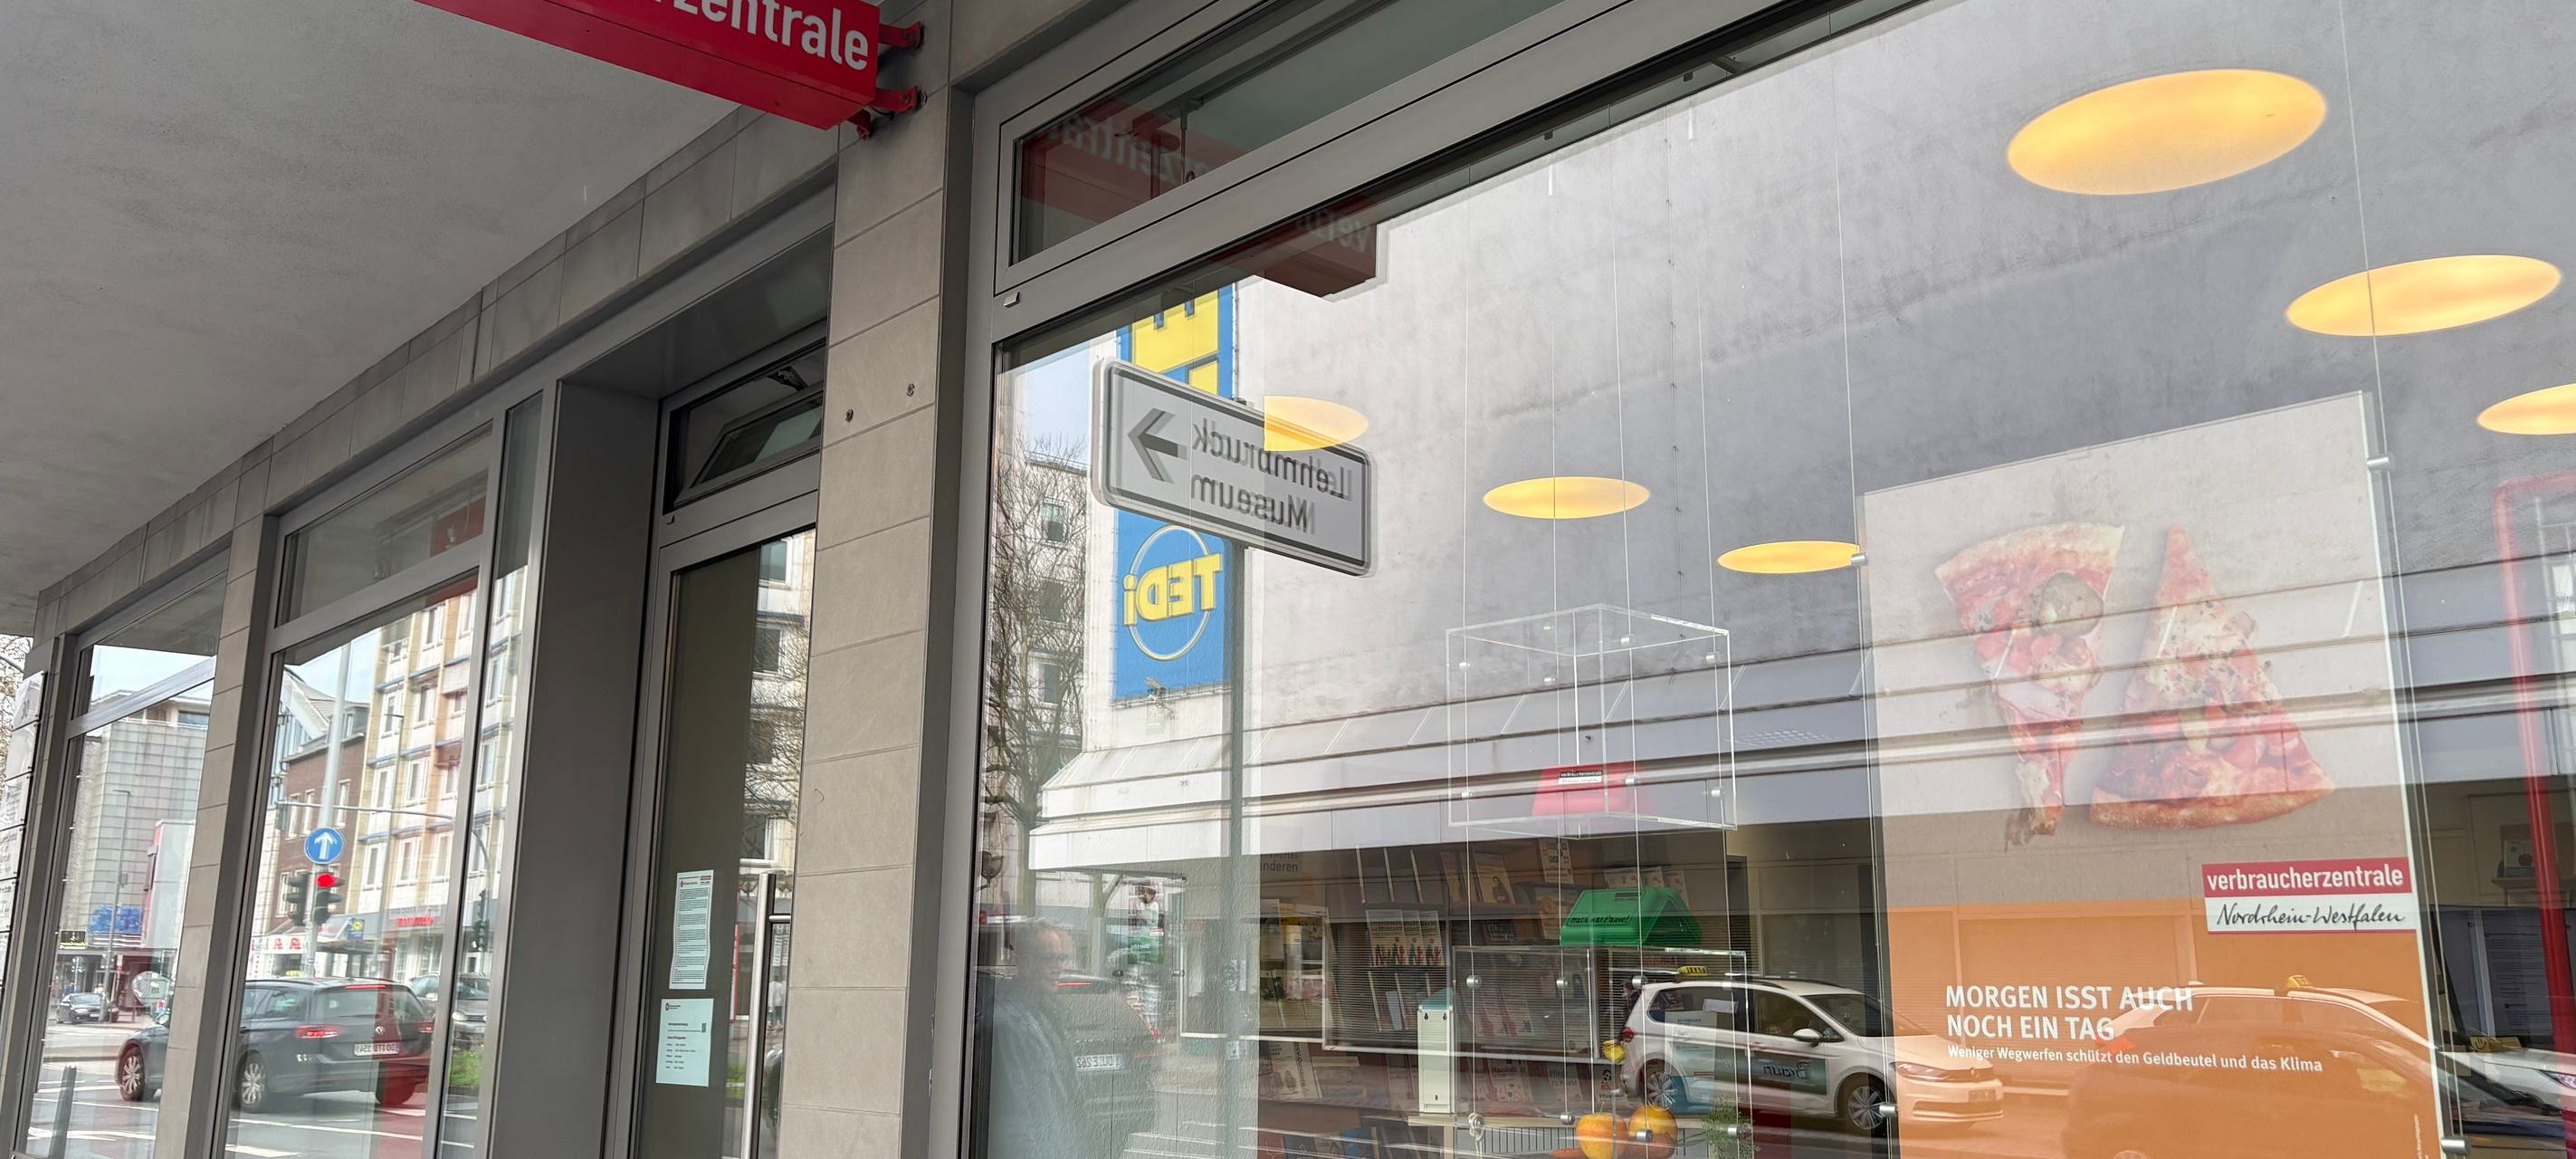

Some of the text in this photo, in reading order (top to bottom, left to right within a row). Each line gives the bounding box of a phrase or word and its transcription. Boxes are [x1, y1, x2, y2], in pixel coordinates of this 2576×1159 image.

[2207, 864, 2404, 891] verbraucherzentrale
[2217, 903, 2406, 931] Nordrhein-Westfalen
[1946, 985, 2193, 1011] MORGEN ISST AUCH
[1947, 1014, 2114, 1041] NOCH EIN TAG
[1947, 1046, 2323, 1072] Weniger Wegwerfen schützt den Geldbeutel und das Klima
[1559, 1078, 1578, 1087] Huse
